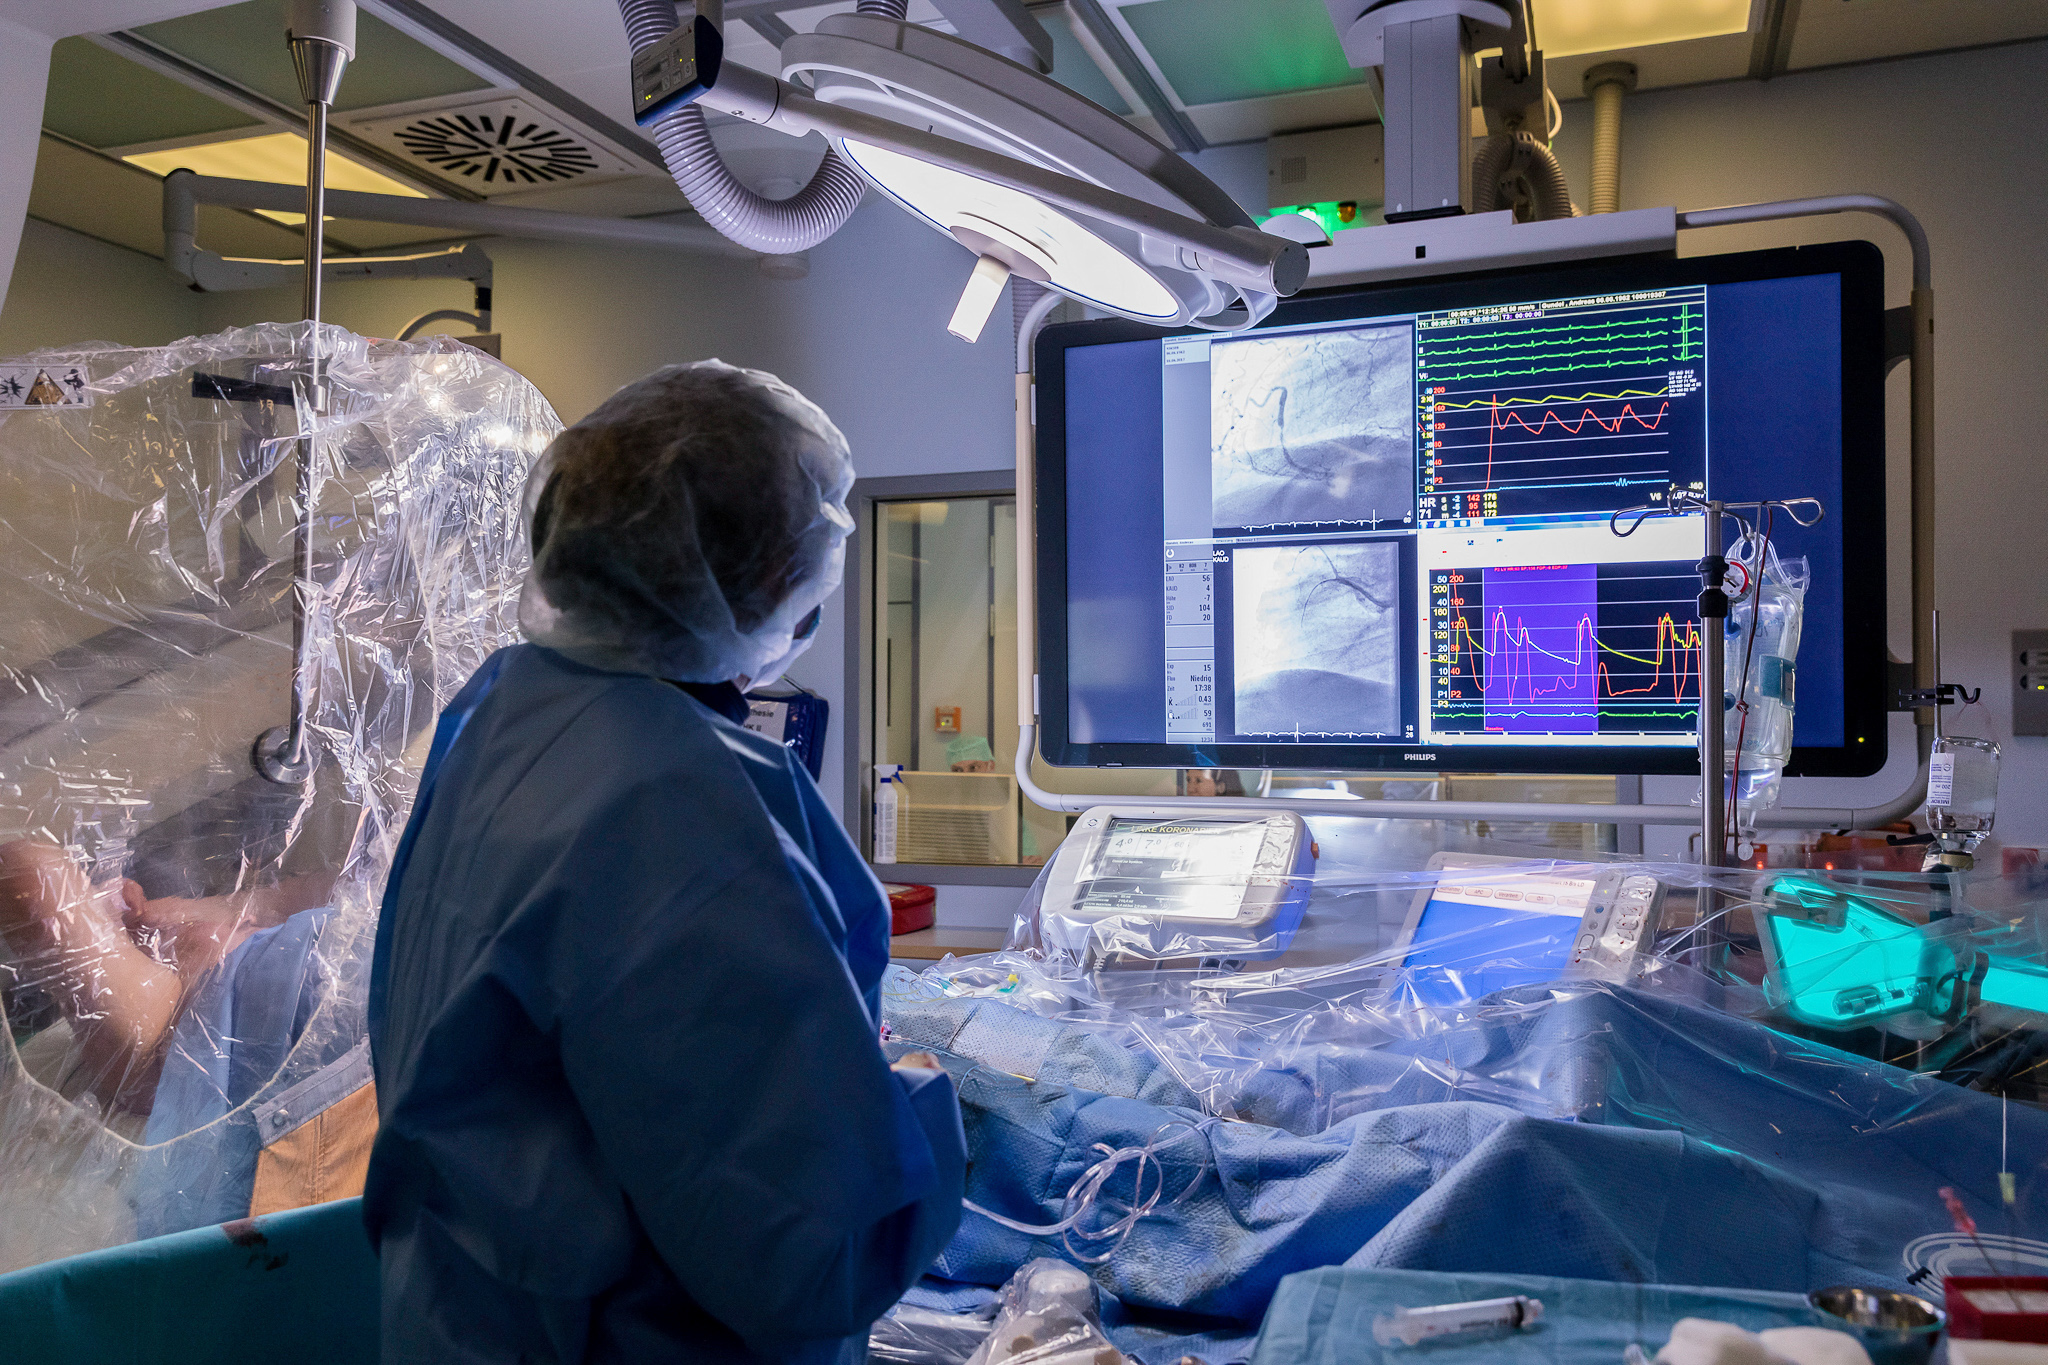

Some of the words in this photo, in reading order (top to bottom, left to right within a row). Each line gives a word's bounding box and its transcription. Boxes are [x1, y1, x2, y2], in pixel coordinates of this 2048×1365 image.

[1419, 498, 1436, 508] HR
[1419, 509, 1431, 519] 71
[1437, 575, 1447, 583] 50
[1433, 585, 1447, 593] 200
[1437, 598, 1448, 606] 40
[1450, 598, 1464, 606] 160
[1434, 608, 1448, 616] 160
[1438, 621, 1448, 629] 30
[1434, 631, 1448, 639] 120
[1438, 644, 1448, 652] 20
[1438, 654, 1448, 662] 80
[1190, 674, 1211, 682] Niedrig
[1438, 690, 1448, 698] P1
